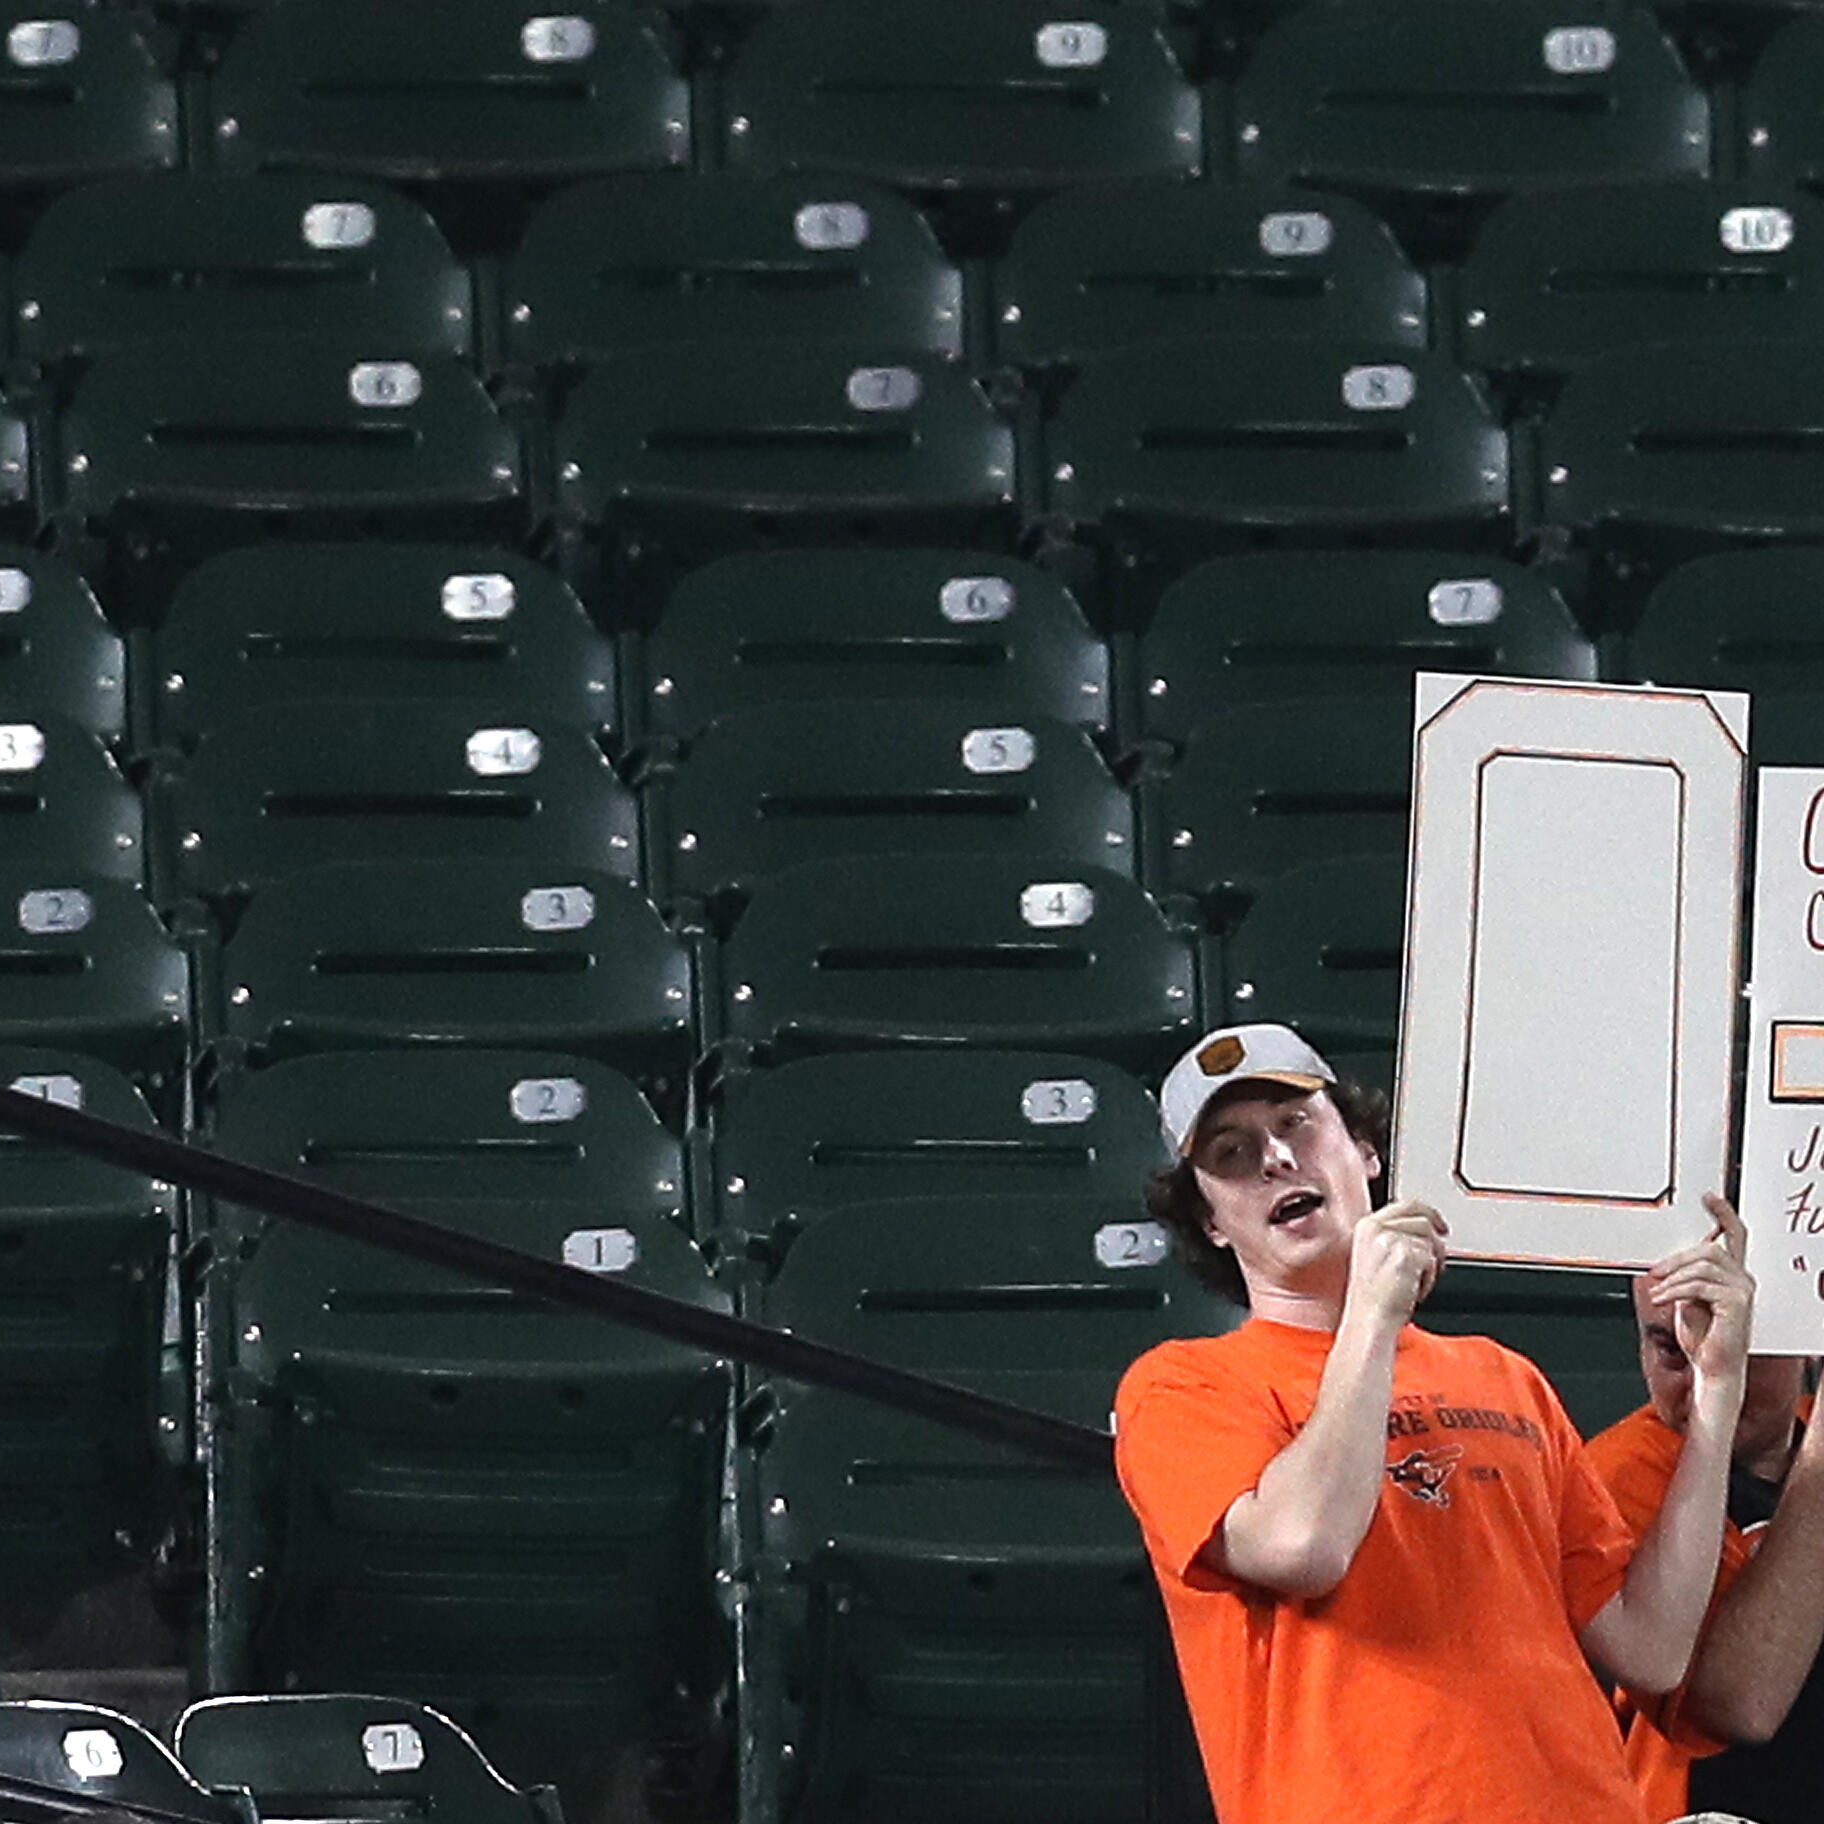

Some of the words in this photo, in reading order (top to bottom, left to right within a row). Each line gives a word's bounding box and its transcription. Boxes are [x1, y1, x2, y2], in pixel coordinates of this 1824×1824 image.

[1563, 34, 1597, 62] 10
[1740, 217, 1776, 245] 10
[376, 369, 395, 397] 6
[874, 373, 890, 401] 7
[1369, 372, 1386, 401] 8
[470, 580, 488, 611] 5
[967, 585, 988, 615] 6
[1455, 585, 1474, 615] 7
[2, 732, 17, 762] 3
[494, 736, 511, 765] 4
[989, 734, 1007, 766] 5
[47, 896, 64, 925] 2
[549, 892, 566, 923] 3
[1046, 890, 1065, 917] 4
[538, 1085, 556, 1115] 2
[1049, 1088, 1067, 1117] 3
[593, 1236, 605, 1265] 1
[1121, 1230, 1140, 1260] 2
[84, 1739, 103, 1768] 6
[382, 1730, 399, 1762] 7
